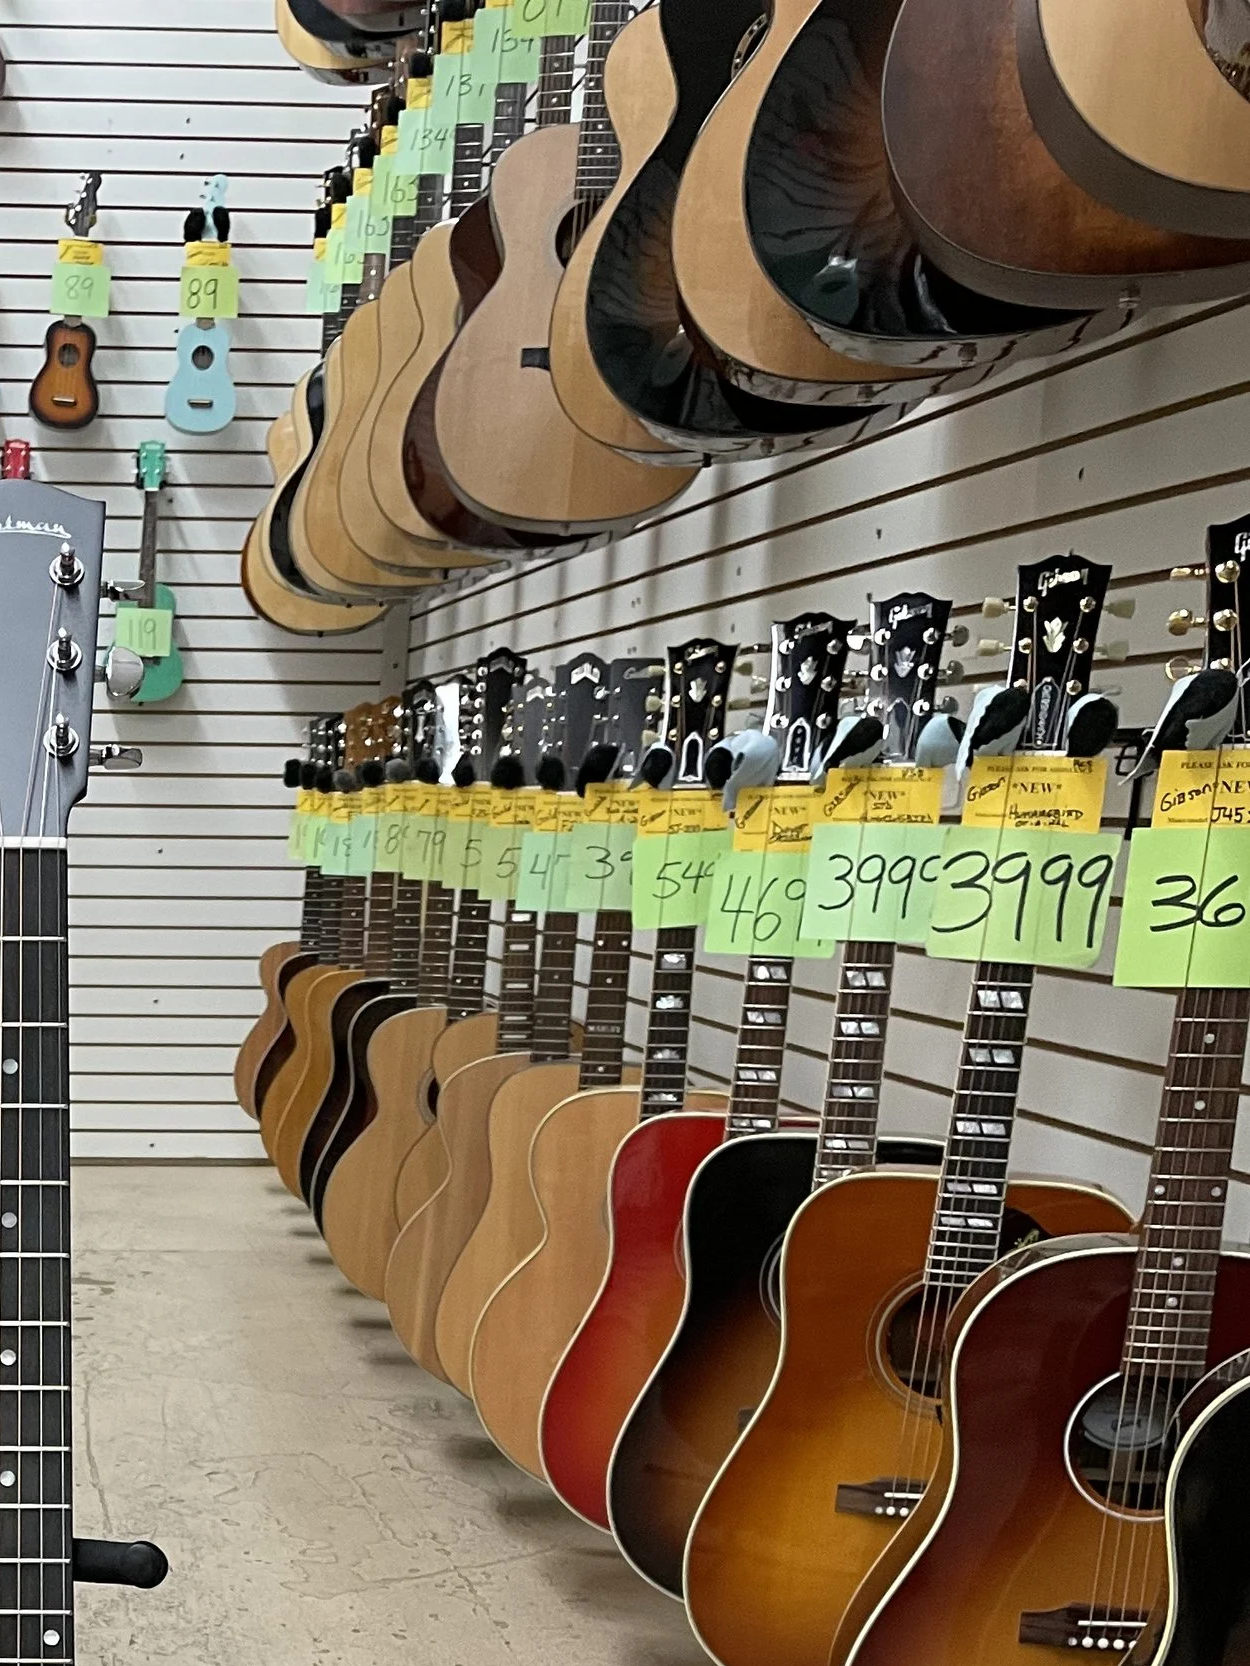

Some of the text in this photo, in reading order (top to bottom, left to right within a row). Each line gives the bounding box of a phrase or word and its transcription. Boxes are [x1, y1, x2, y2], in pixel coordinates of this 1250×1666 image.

[64, 274, 94, 300] 89
[185, 277, 218, 310] 89
[128, 617, 157, 650] 119
[931, 850, 1114, 949] 3999
[1149, 874, 1247, 933] 36
